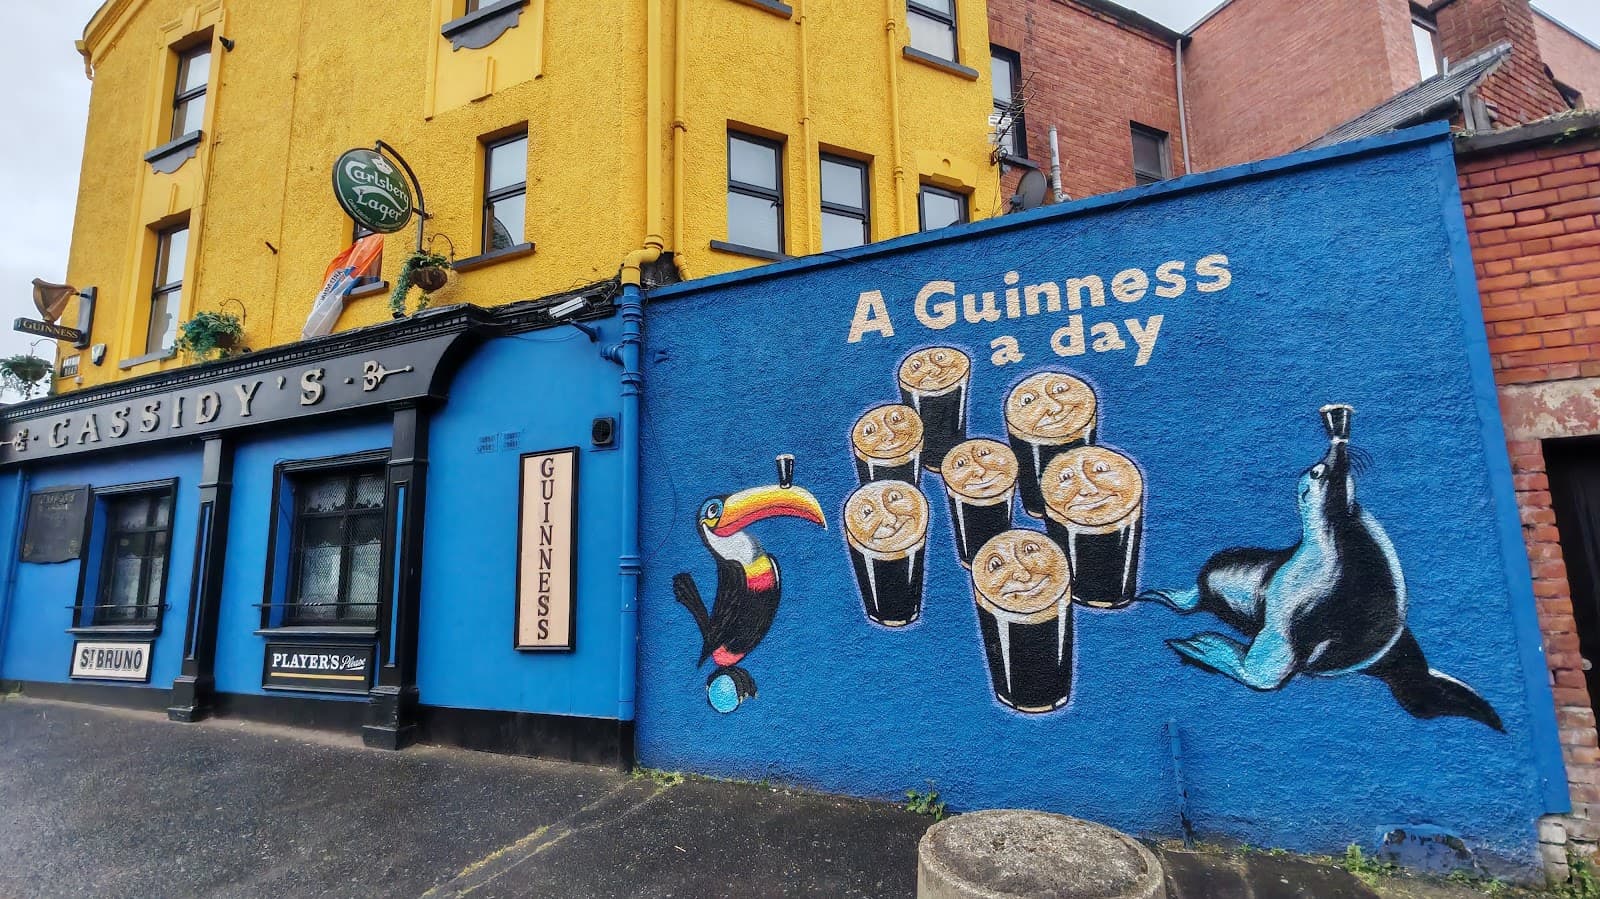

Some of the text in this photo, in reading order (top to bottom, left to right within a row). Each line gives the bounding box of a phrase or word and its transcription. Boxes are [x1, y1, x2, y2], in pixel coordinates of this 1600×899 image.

[345, 160, 409, 211] Carlsberg
[355, 191, 402, 221] Lager
[847, 254, 1232, 343] A Guinness
[23, 320, 79, 339] GUINNESS
[990, 315, 1165, 367] a day
[48, 368, 326, 448] CASSIDY'S
[538, 457, 555, 640] GUINNESS
[96, 648, 143, 670] BRUNO
[272, 653, 340, 670] PLAYER'S
